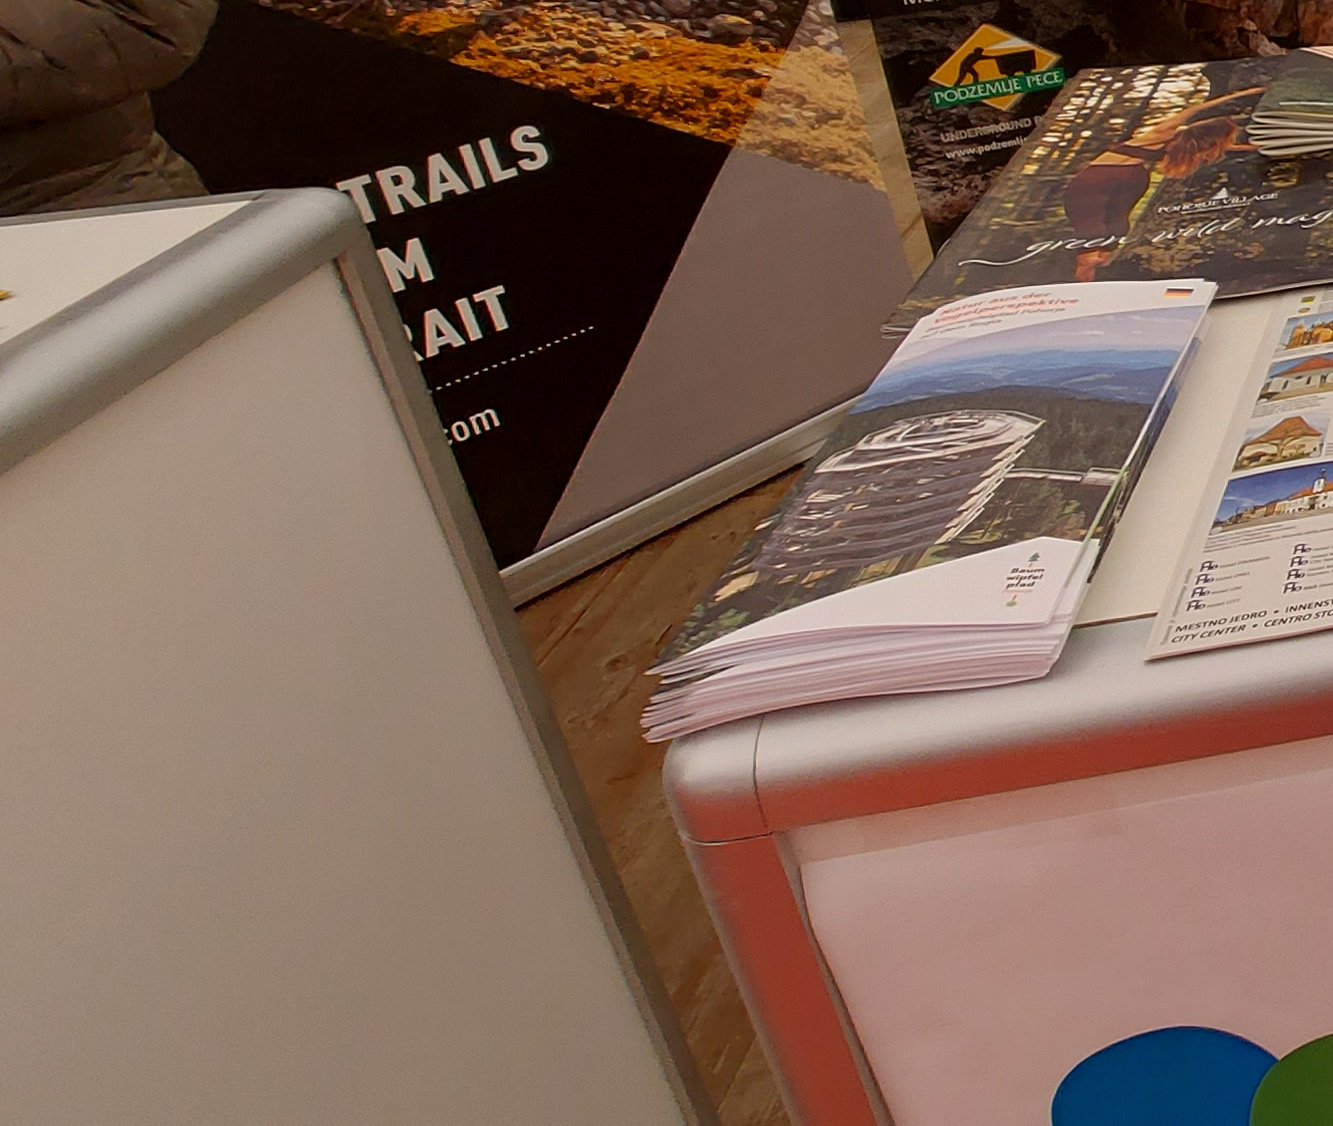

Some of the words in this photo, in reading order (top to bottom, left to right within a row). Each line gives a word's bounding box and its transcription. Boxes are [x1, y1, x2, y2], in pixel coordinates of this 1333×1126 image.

[934, 76, 1024, 106] PODZEMLJE
[941, 118, 1032, 142] UNDERGROUND
[336, 125, 549, 224] TRAILS
[991, 294, 1018, 302] aus
[1021, 292, 1052, 300] der
[1006, 573, 1043, 584] wipfel
[1011, 566, 1045, 575] Baum
[1005, 580, 1036, 590] pfad
[1171, 633, 1198, 643] CITY
[1200, 624, 1247, 639] CENTER
[1264, 614, 1312, 628] CENTRO
[1175, 618, 1227, 633] MESTNO
[1229, 610, 1267, 625] JEDRO
